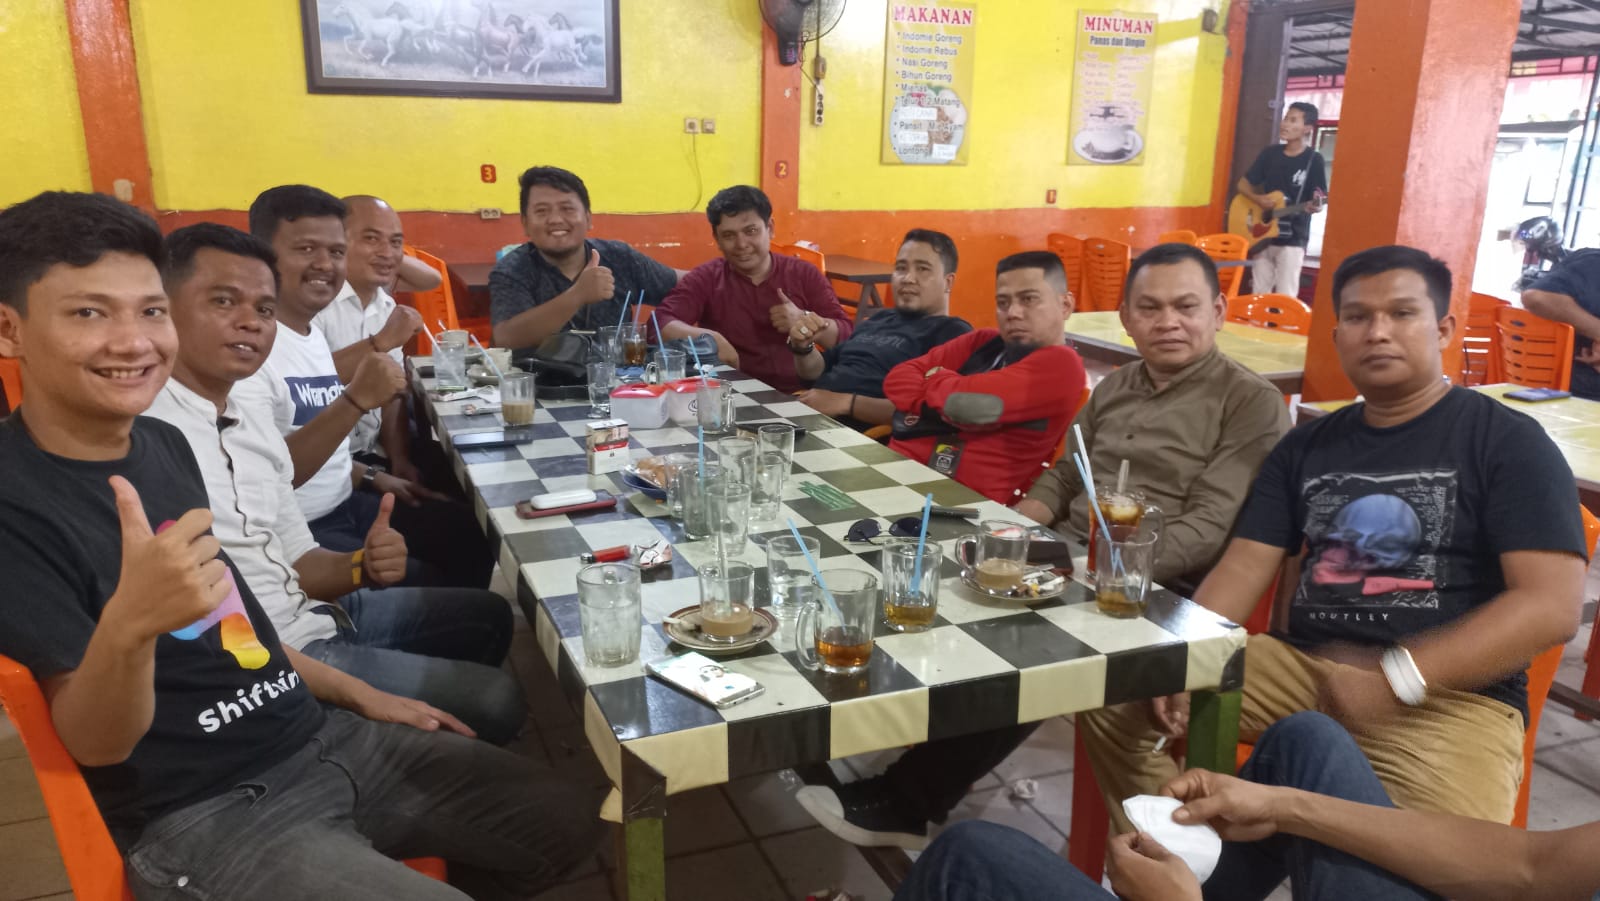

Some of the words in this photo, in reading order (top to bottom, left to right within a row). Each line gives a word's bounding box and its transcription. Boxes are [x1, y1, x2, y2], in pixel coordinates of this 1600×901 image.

[894, 6, 972, 24] MAKANAN
[1085, 17, 1153, 33] MINUMAN
[902, 32, 932, 41] Indomie
[935, 34, 962, 44] Goreng
[1090, 36, 1110, 45] Panas
[1111, 37, 1123, 46] dan
[902, 45, 932, 54] Indomie
[934, 47, 958, 56] Rebus
[901, 58, 918, 66] Nasi
[920, 59, 948, 69] Goreng
[901, 70, 923, 80] Bihun
[925, 72, 952, 83] Goreng
